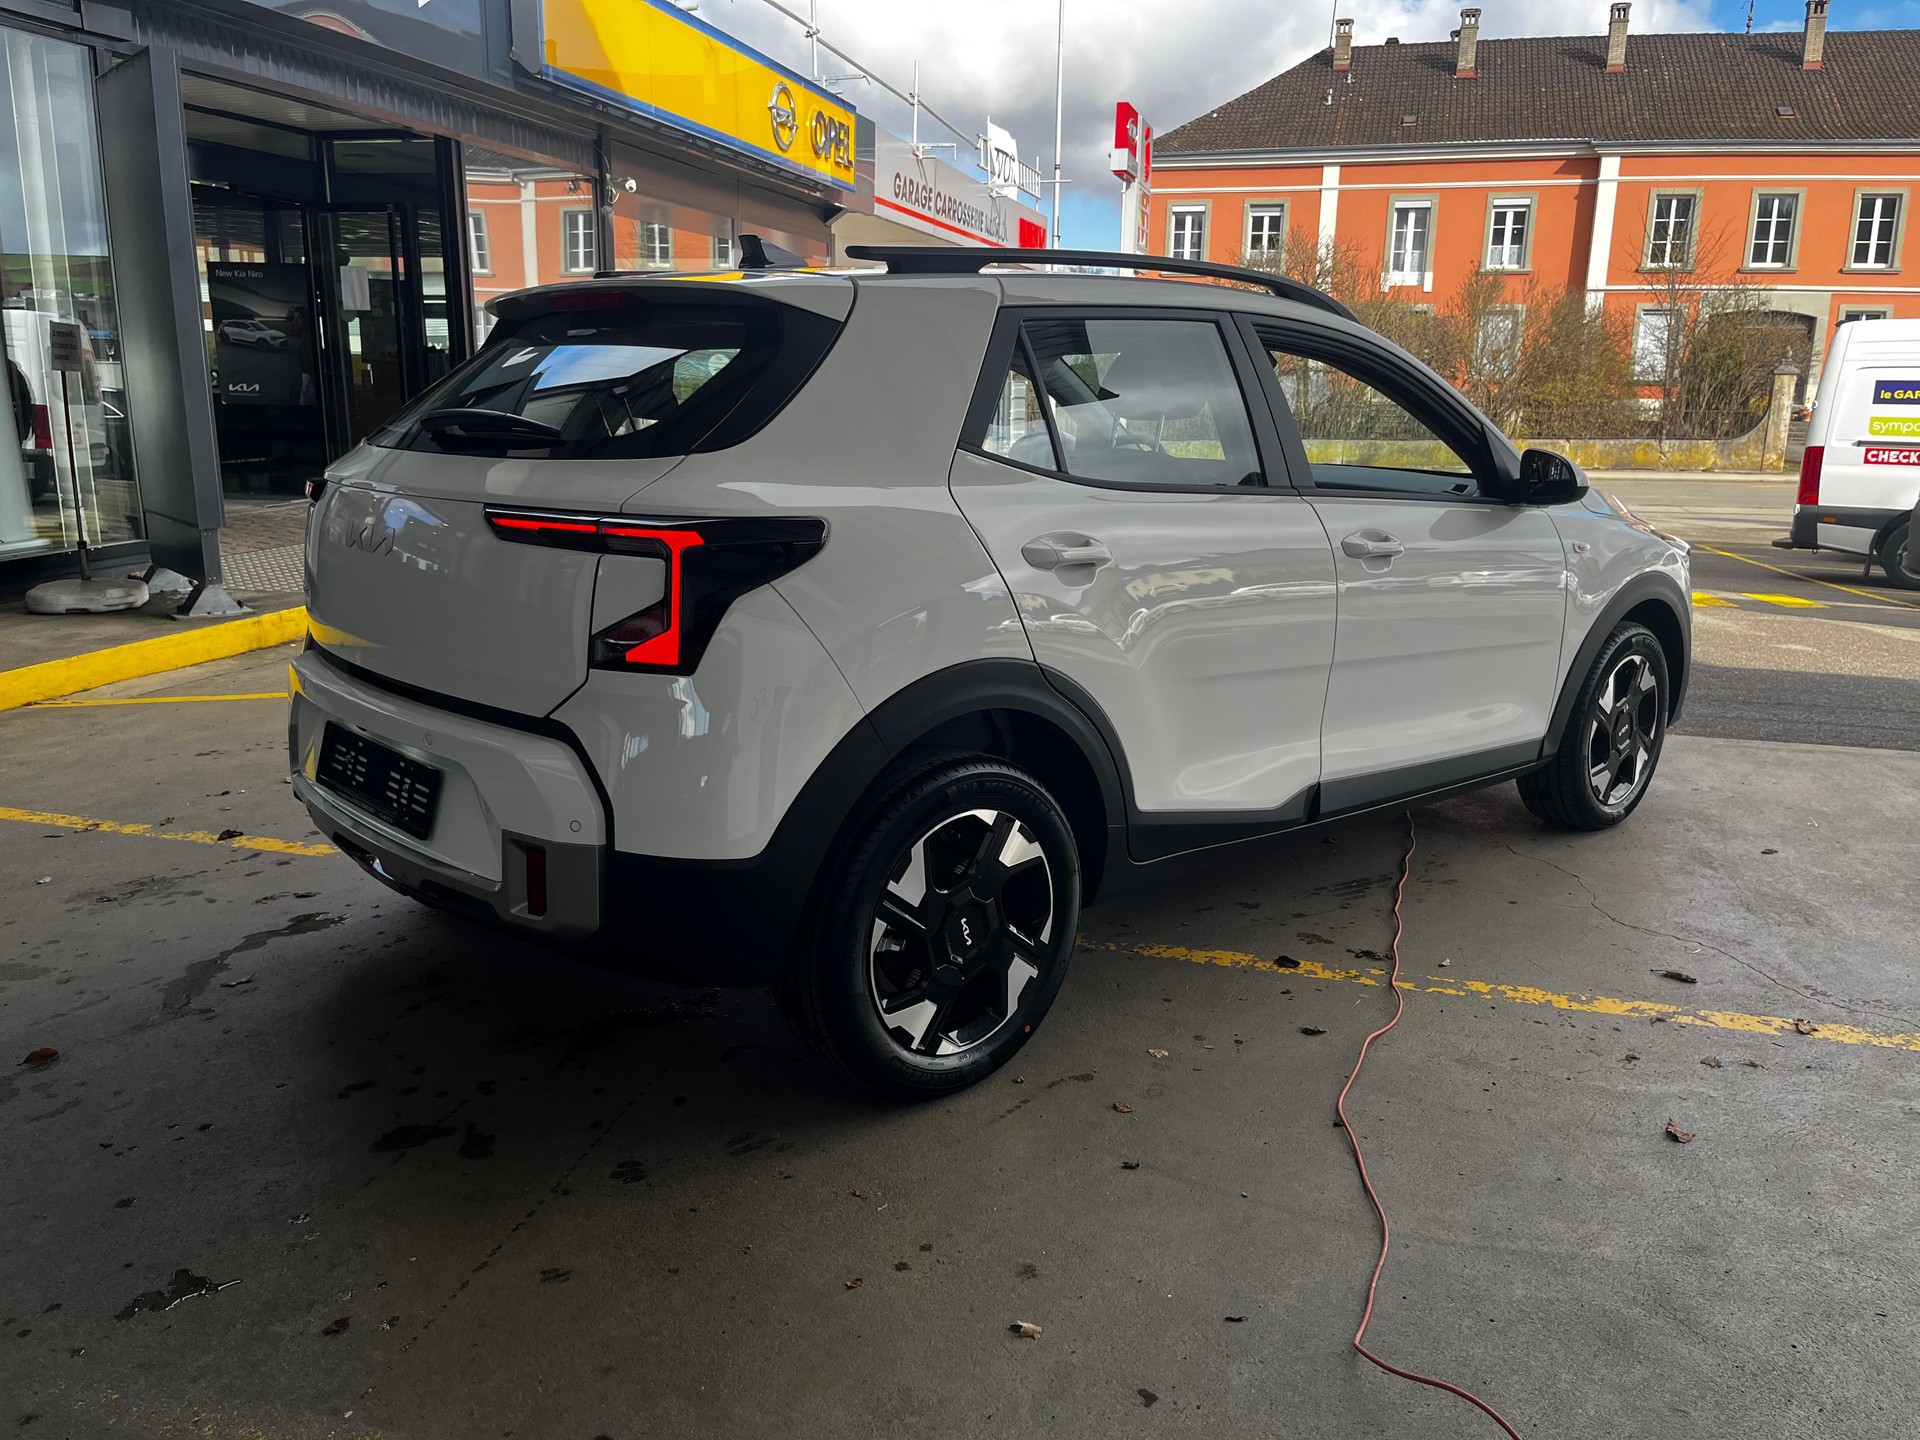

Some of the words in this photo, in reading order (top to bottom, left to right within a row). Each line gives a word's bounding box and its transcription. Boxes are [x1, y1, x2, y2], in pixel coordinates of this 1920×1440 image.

[814, 111, 854, 168] OPEL
[893, 171, 933, 212] GARAGE
[935, 191, 984, 233] CARROSSERIE
[215, 269, 232, 278] New
[234, 269, 246, 278] Kia
[248, 270, 264, 279] Niro
[228, 383, 260, 392] KIA
[1880, 389, 1892, 399] le
